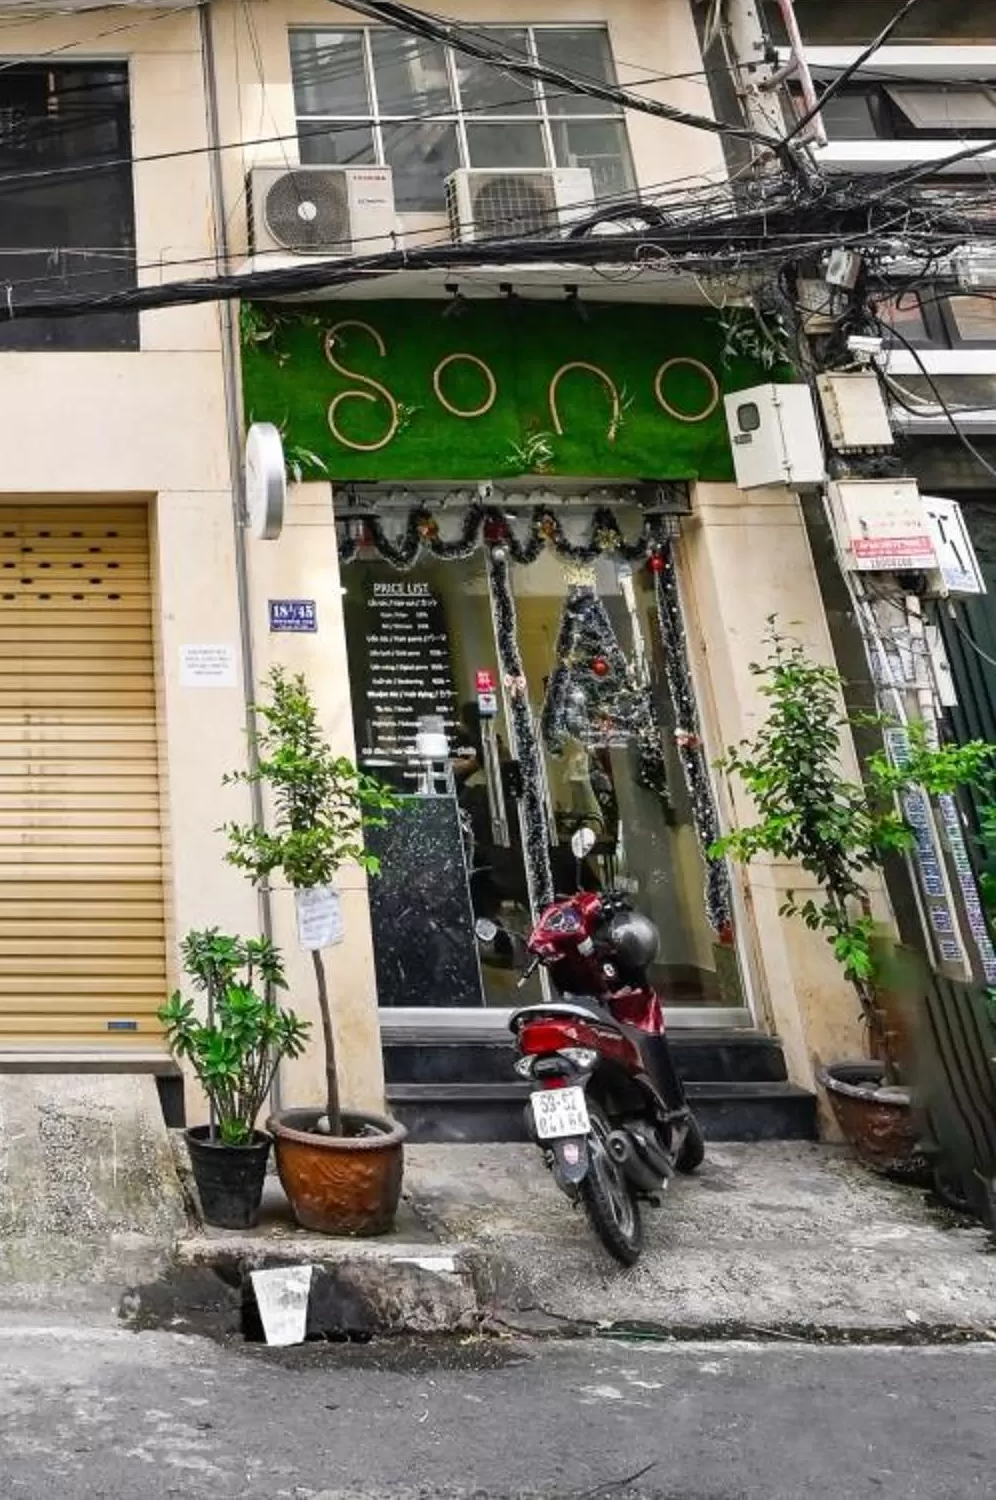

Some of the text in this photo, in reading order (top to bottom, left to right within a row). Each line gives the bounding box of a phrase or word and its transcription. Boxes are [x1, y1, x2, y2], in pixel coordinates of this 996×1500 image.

[324, 320, 720, 452] Sono
[374, 583, 429, 594] PRICE LIST
